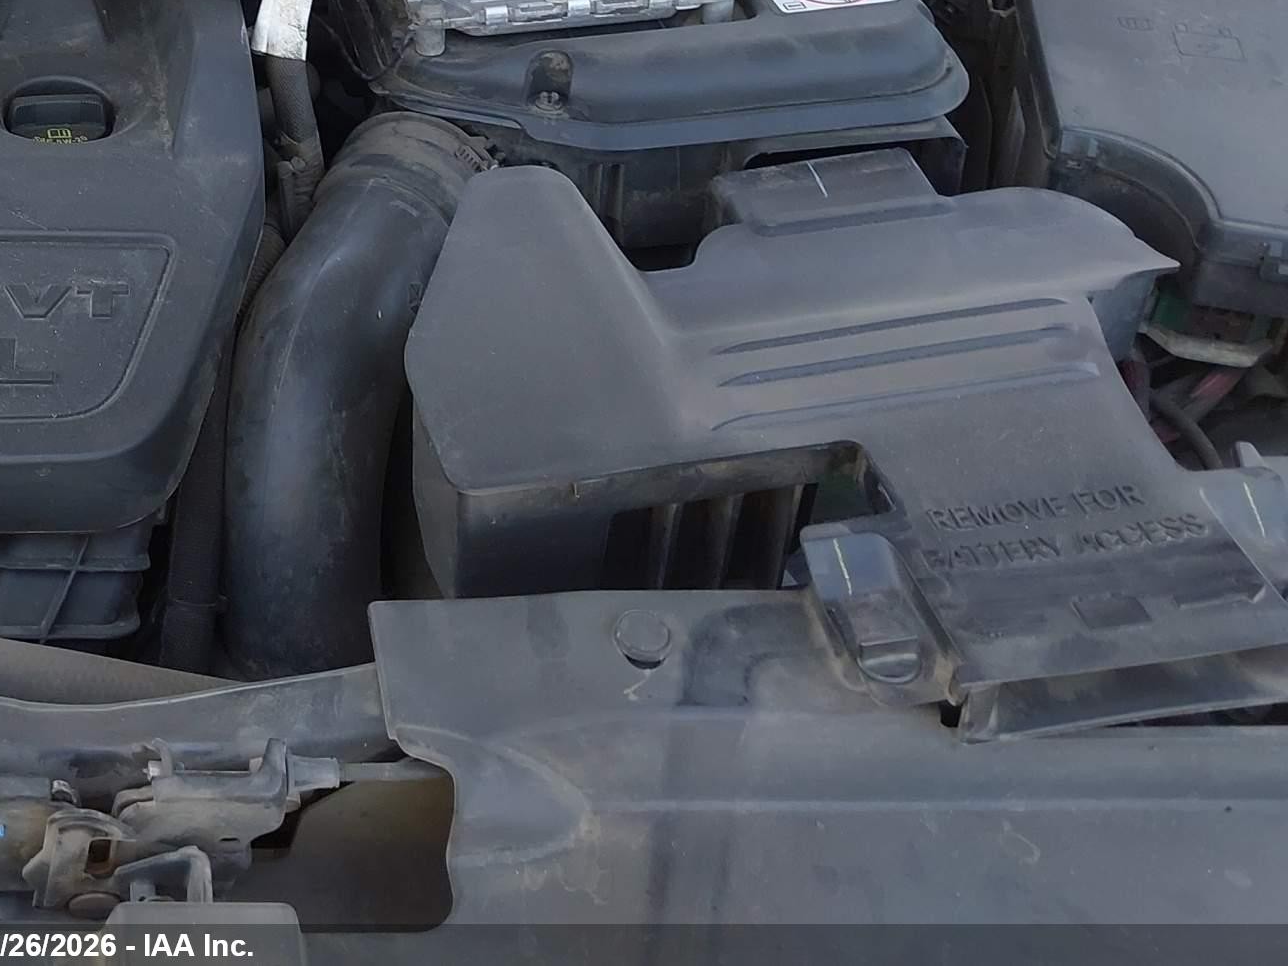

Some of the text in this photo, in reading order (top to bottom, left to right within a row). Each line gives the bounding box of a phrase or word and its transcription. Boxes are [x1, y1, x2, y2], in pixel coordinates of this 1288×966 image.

[925, 483, 1146, 531] REMOVE FOR
[923, 513, 1209, 570] BATTERY ACCESS
